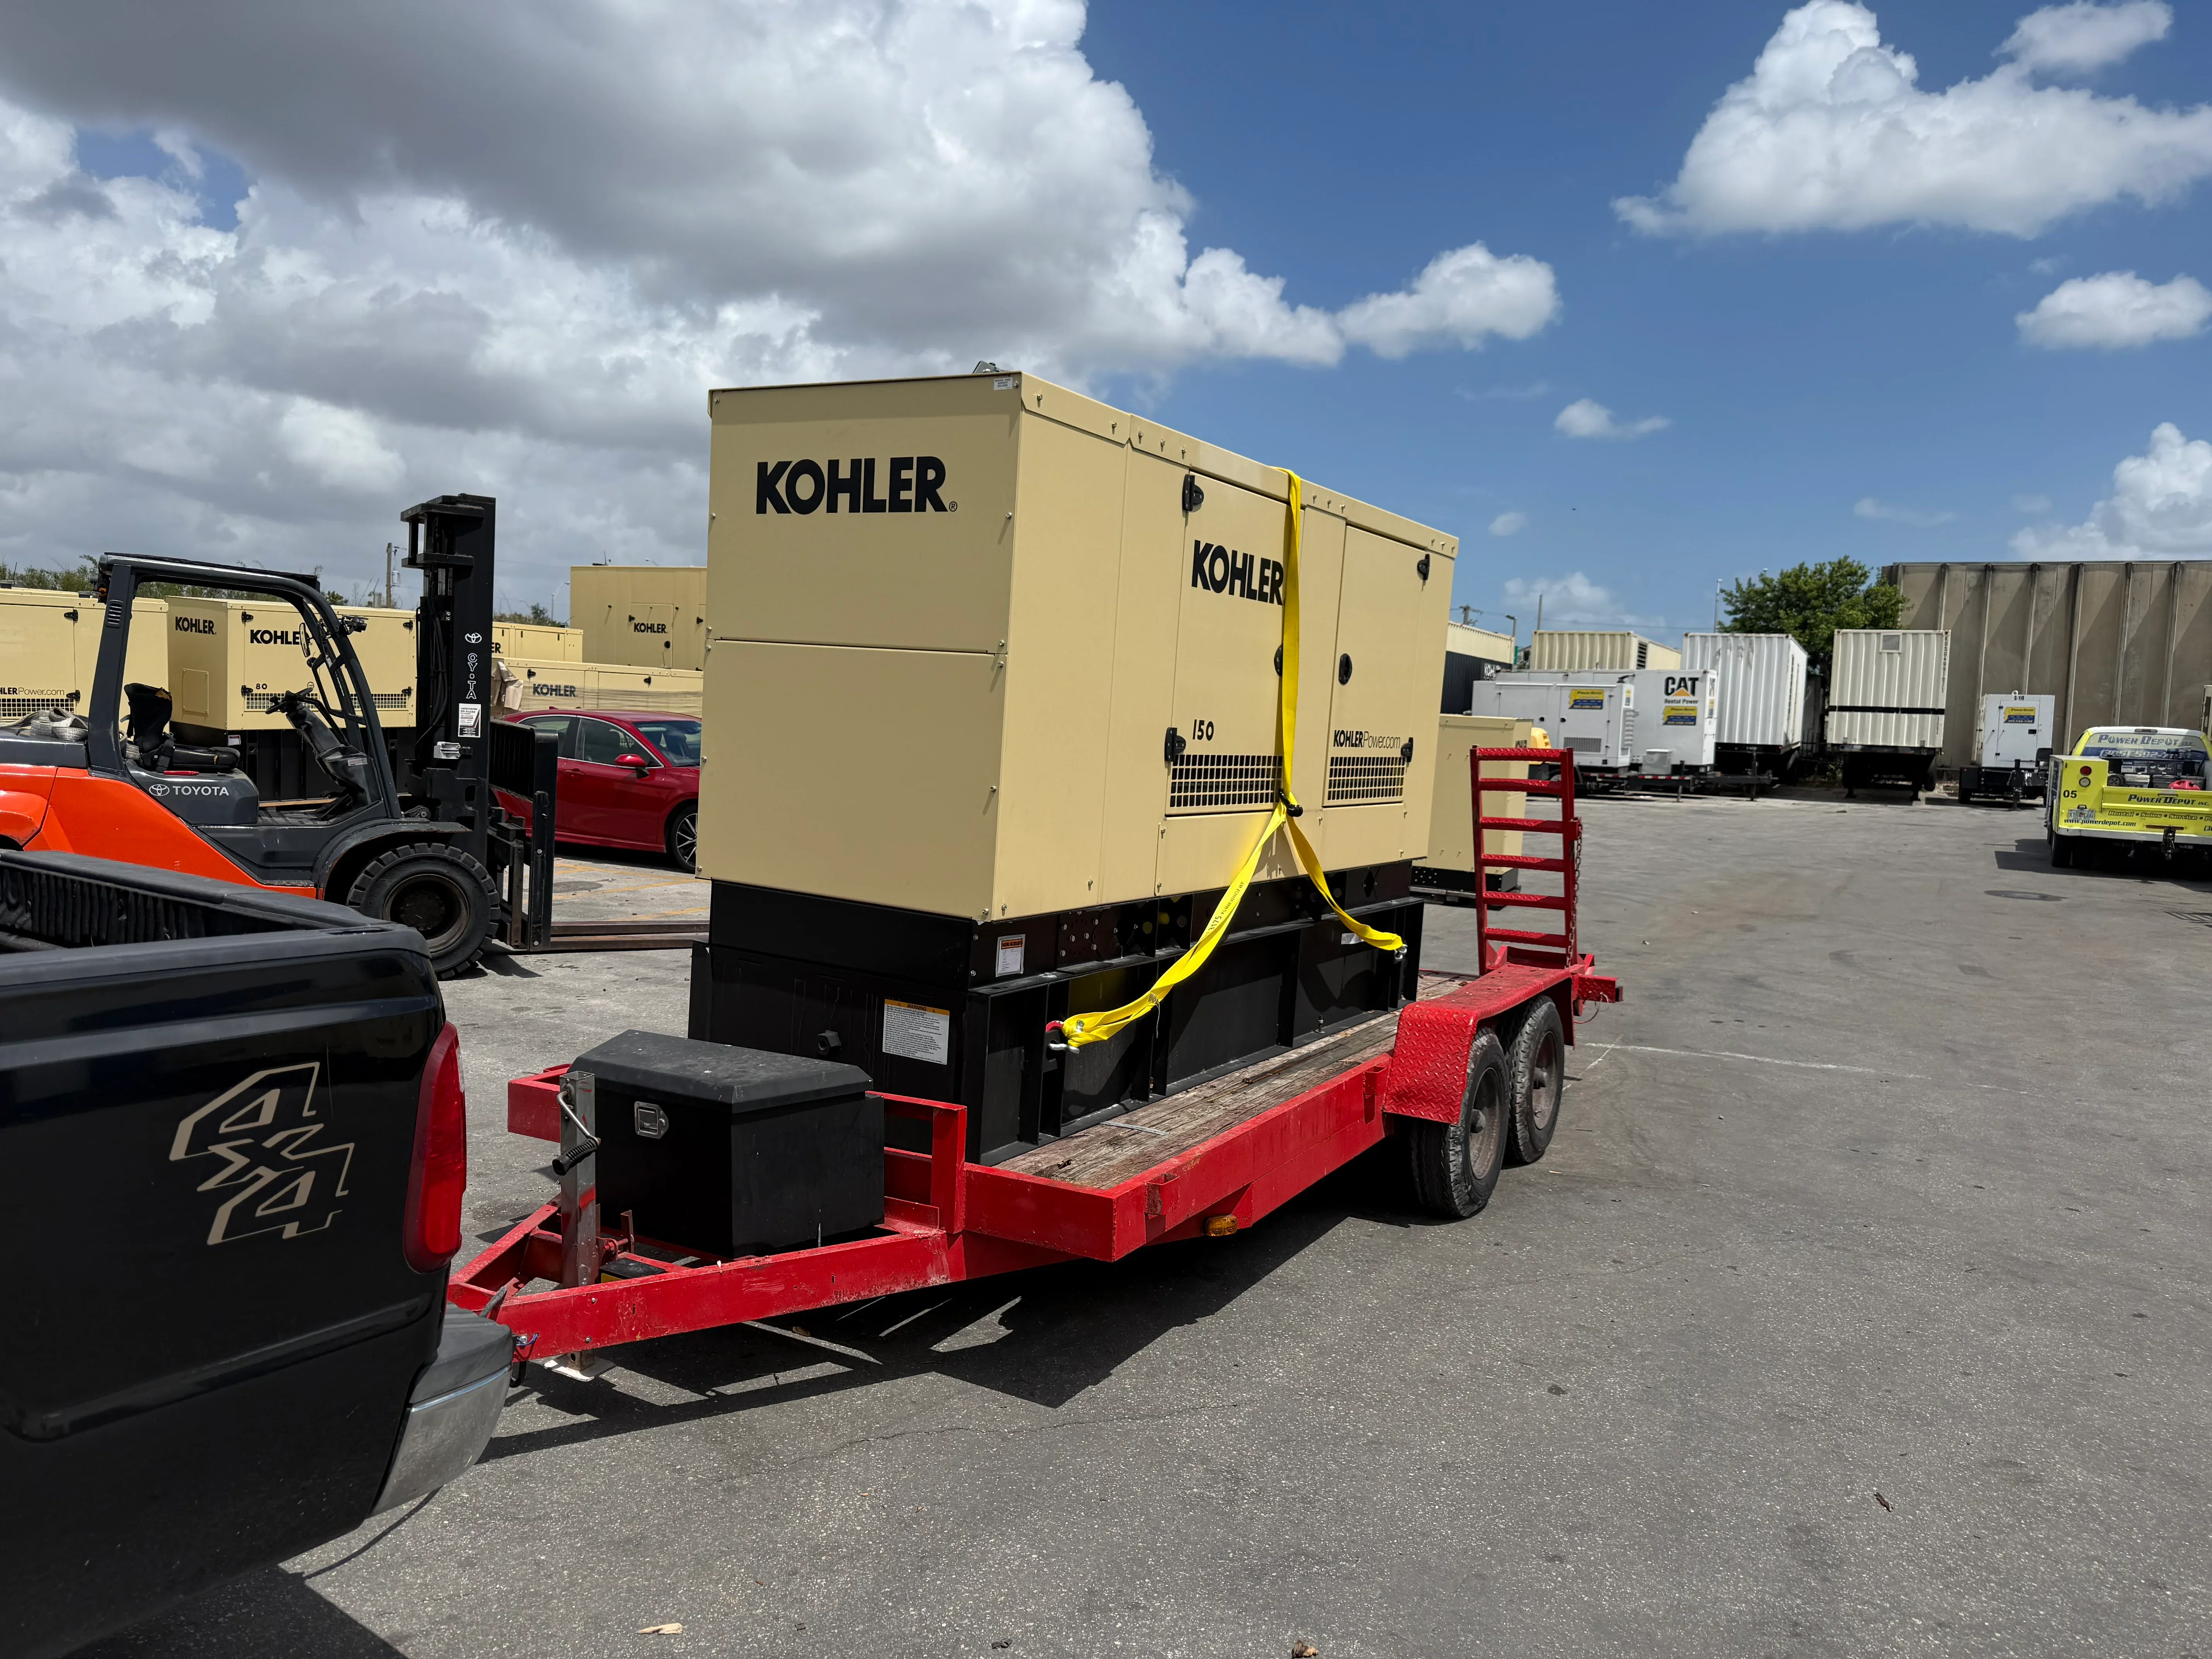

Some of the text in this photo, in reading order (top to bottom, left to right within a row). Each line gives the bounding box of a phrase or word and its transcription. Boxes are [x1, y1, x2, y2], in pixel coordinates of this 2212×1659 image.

[756, 456, 948, 515] KOHLER
[1192, 540, 1283, 606] KOHLER
[175, 616, 215, 635] KOHLER
[634, 622, 666, 634] KOHLER
[250, 629, 302, 645] KOHLE
[532, 683, 576, 697] KOHLER
[1664, 677, 1699, 696] CAT
[1192, 719, 1214, 741] 150
[1333, 730, 1401, 749] KOHLERPower.com
[173, 786, 229, 796] TOYOTA
[2063, 790, 2077, 798] 05
[2128, 794, 2162, 804] POWER
[2163, 795, 2196, 805] DEPOT
[2064, 819, 2136, 827] www.powerdepot.com
[907, 1003, 927, 1012] WARNING
